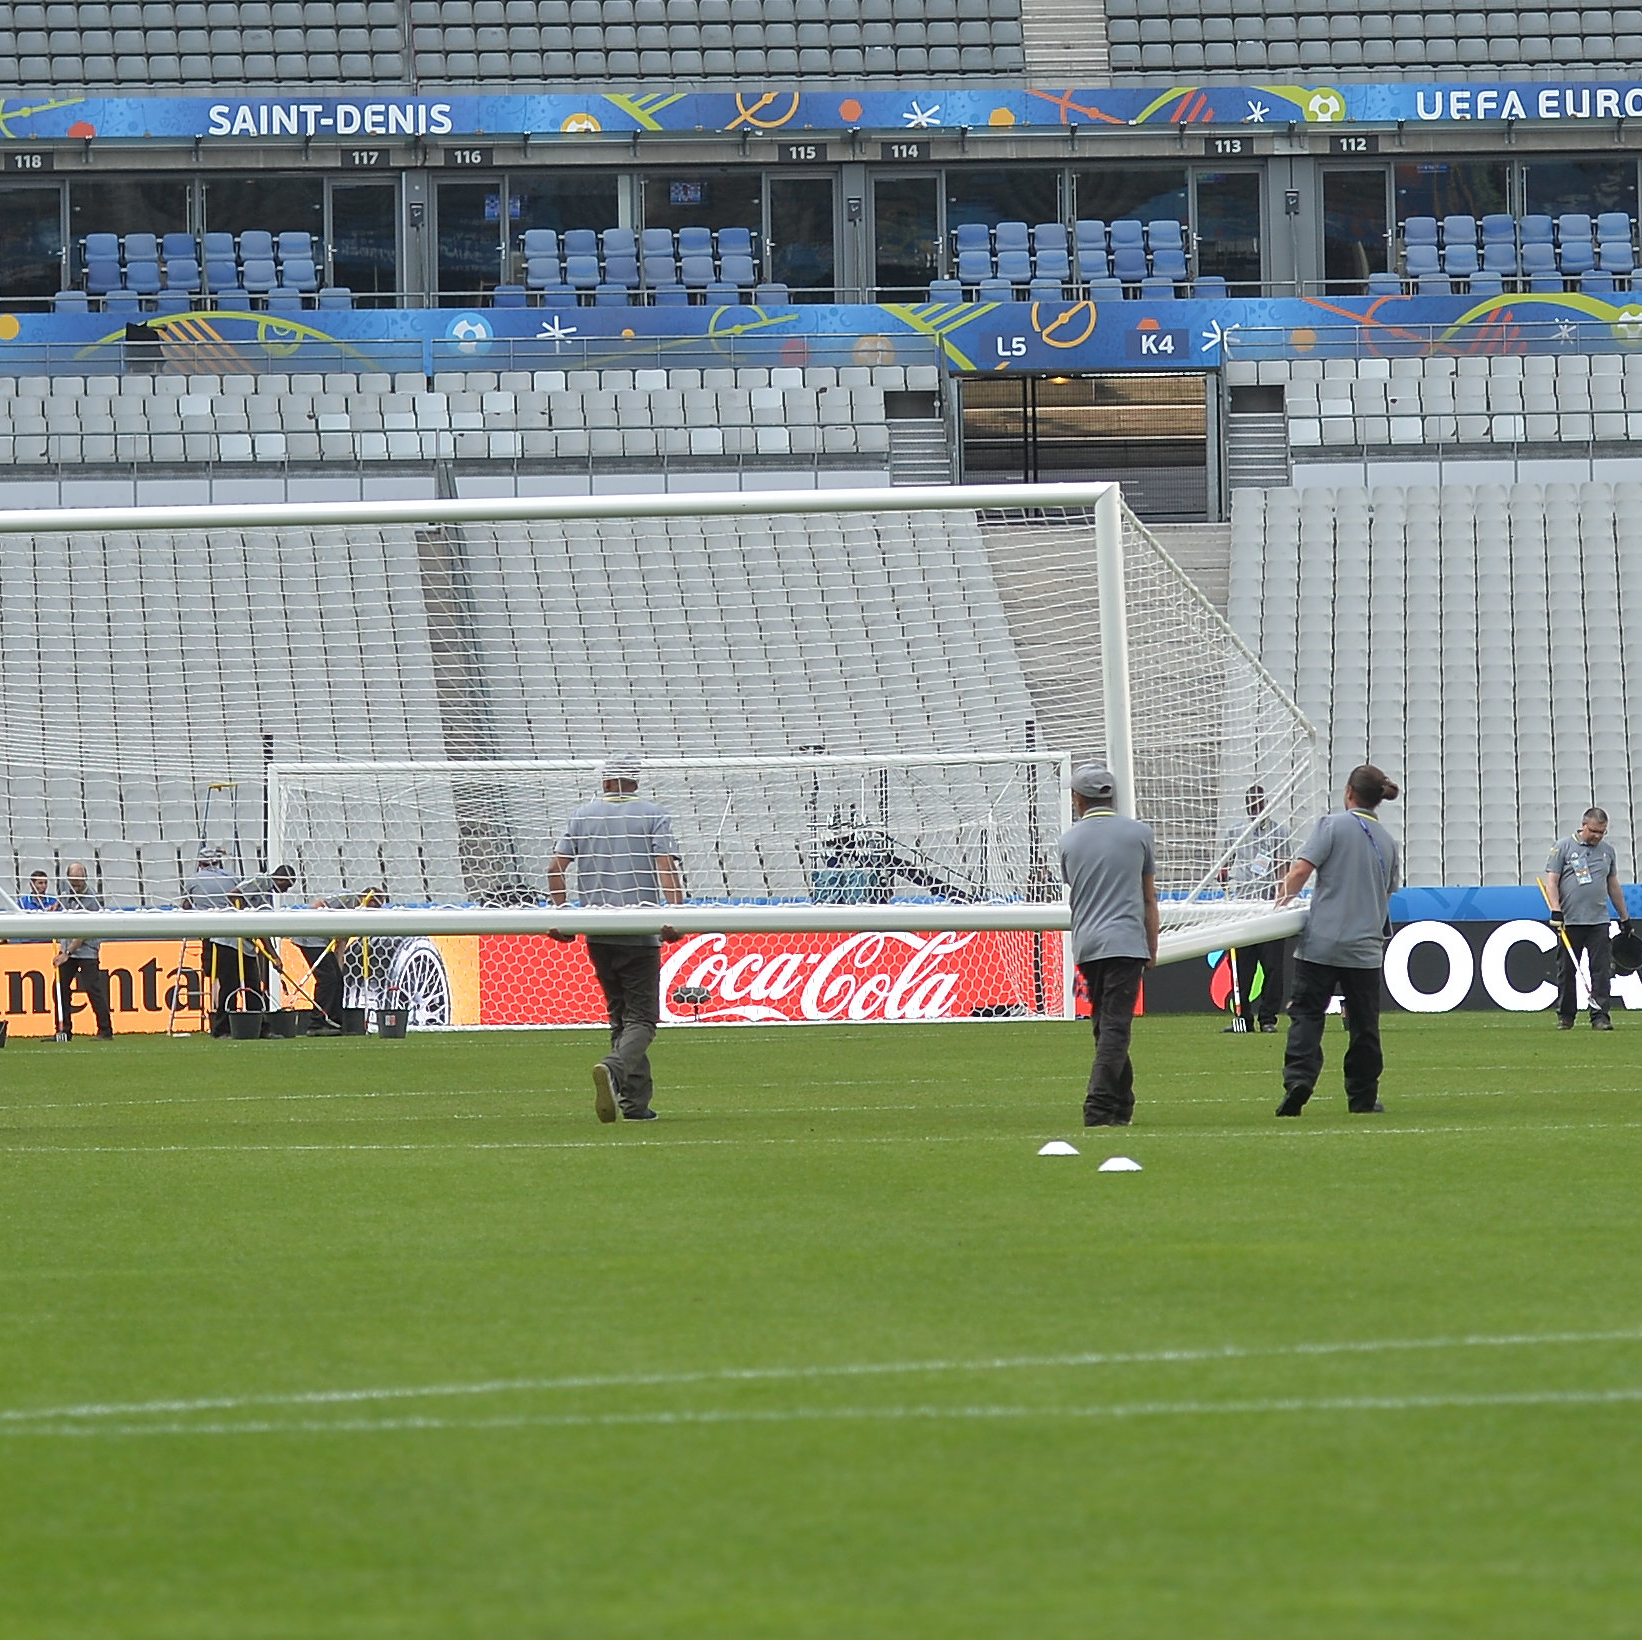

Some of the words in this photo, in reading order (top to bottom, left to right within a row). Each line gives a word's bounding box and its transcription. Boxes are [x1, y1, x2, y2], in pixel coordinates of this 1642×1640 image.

[1417, 91, 1526, 120] UEFA
[209, 104, 452, 136] SAINT-DENIS
[892, 145, 918, 157] 114
[1215, 140, 1241, 153] 113
[1340, 138, 1366, 151] 112
[353, 152, 378, 164] 117
[455, 151, 481, 163] 116
[790, 147, 815, 159] 115
[15, 155, 41, 168] 118
[998, 337, 1026, 355] L5
[1142, 335, 1174, 354] K4
[658, 930, 976, 1022] Coca-Cola
